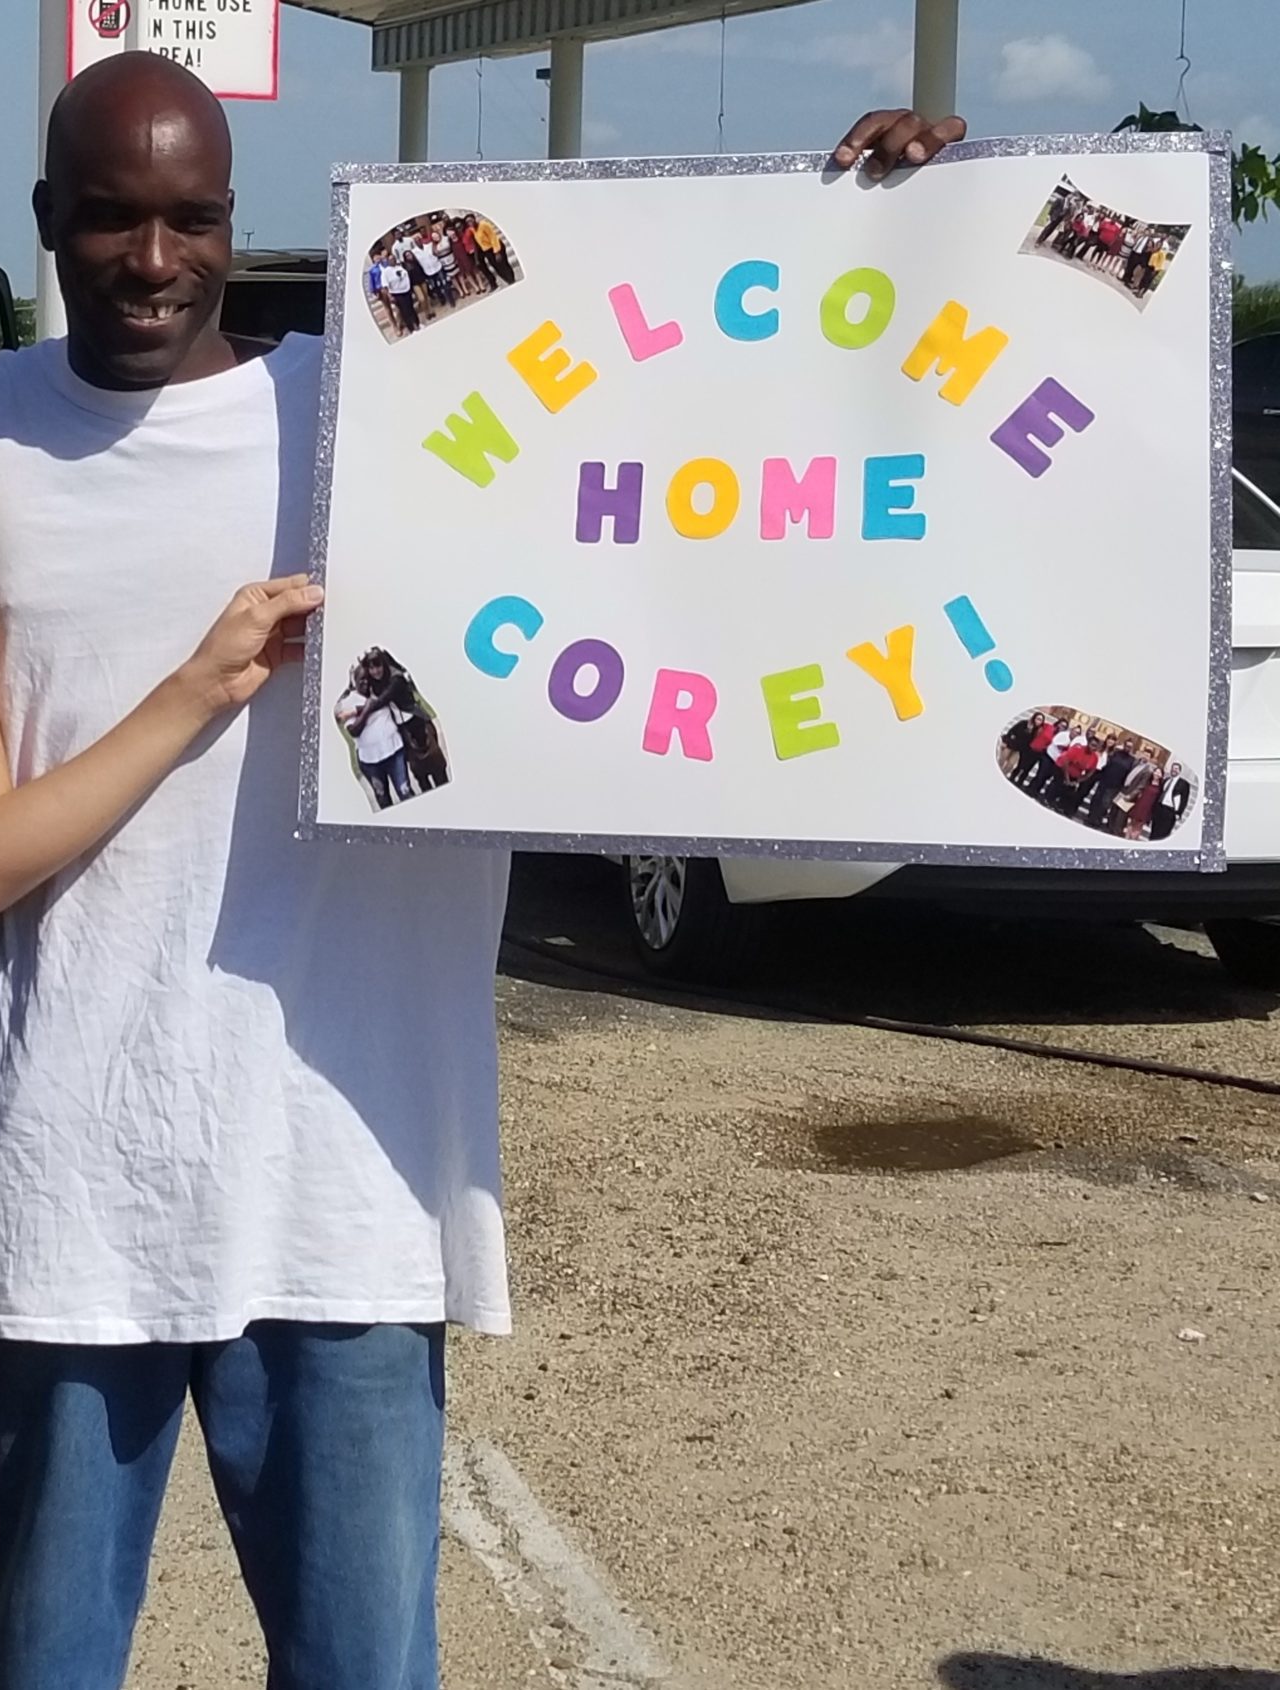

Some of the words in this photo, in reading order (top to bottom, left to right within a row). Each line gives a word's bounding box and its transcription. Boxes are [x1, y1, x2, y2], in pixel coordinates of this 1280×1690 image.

[173, 20, 216, 40] THIS
[217, 0, 252, 13] USE
[148, 47, 202, 67] REA!
[422, 259, 1094, 488] WELCOME
[576, 453, 927, 543] HOME
[464, 595, 1014, 762] COREY!
